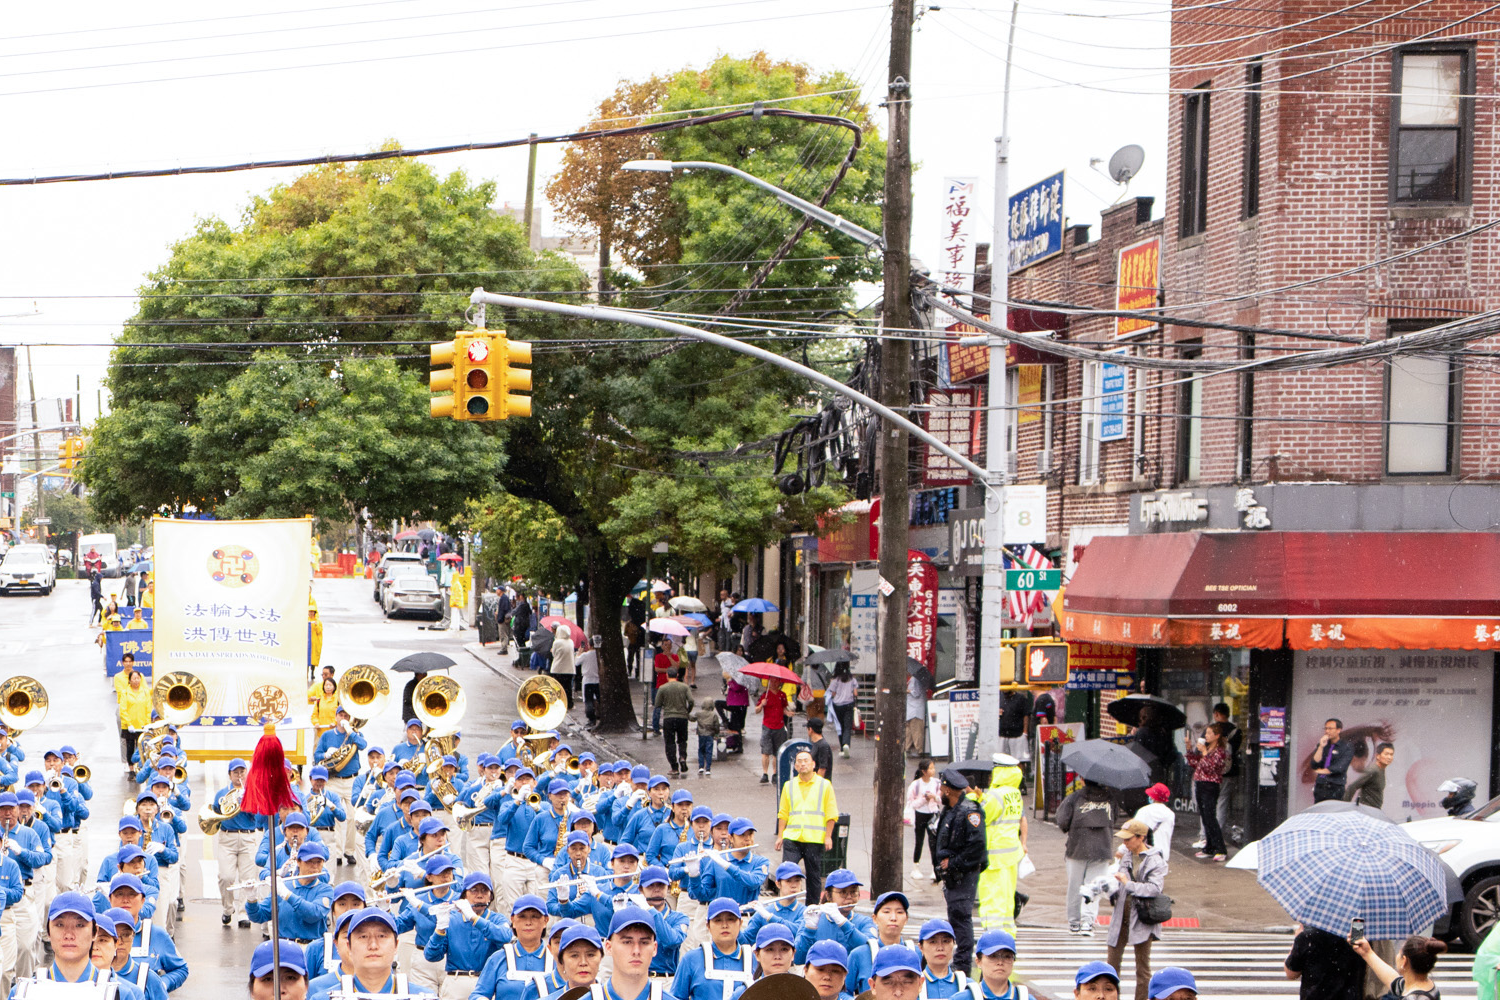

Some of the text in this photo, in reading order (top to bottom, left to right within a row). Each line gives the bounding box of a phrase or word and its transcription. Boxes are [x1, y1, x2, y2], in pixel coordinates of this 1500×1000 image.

[1017, 571, 1047, 588] 60 St
[184, 603, 281, 622] 法輪大法
[1218, 603, 1238, 612] 6002
[184, 627, 280, 647] 洪傳世界
